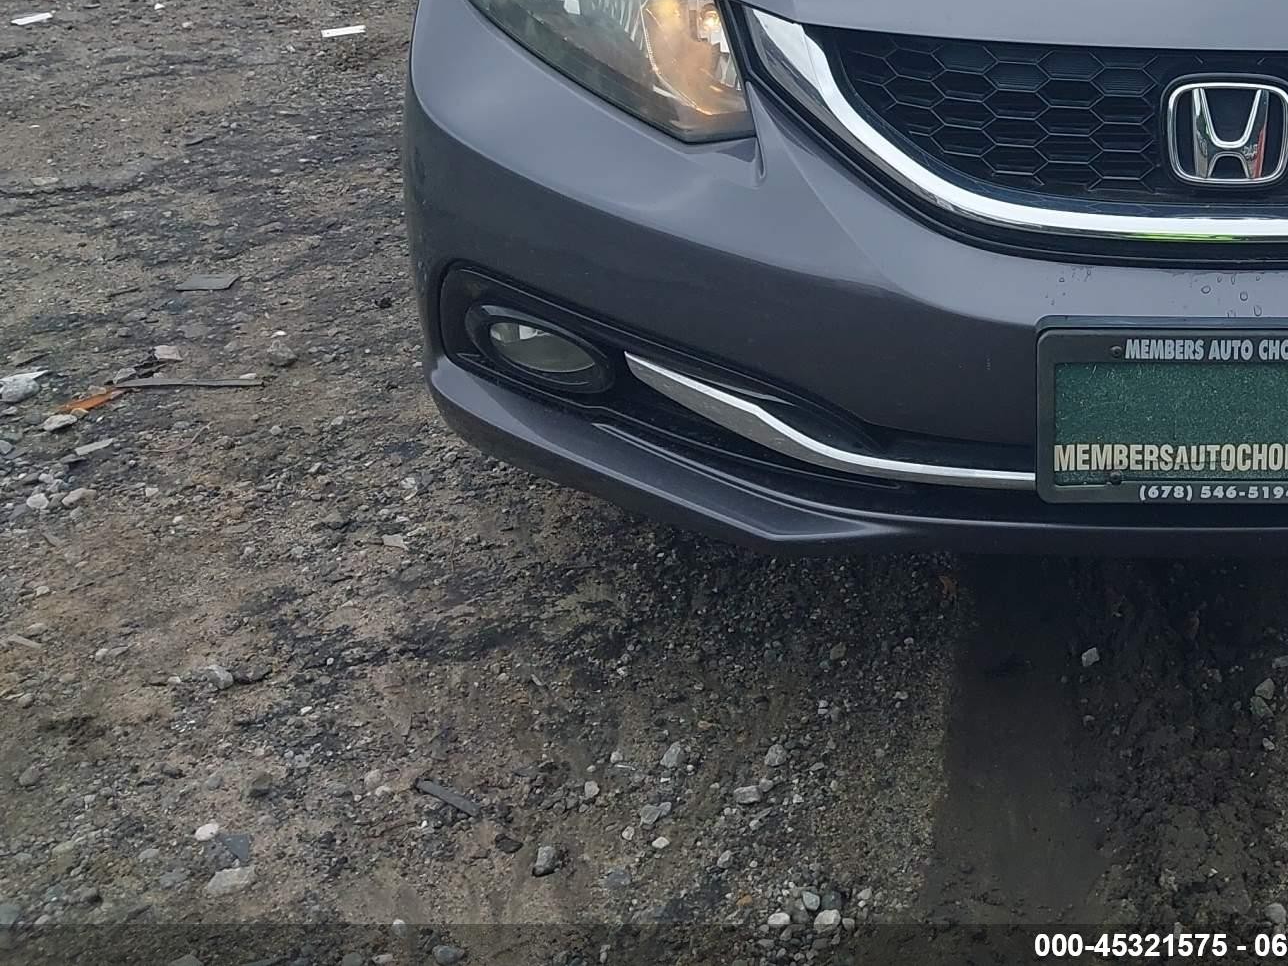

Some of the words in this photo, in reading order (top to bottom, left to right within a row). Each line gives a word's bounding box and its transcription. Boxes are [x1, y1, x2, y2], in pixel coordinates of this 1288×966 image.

[1124, 338, 1204, 361] MEMBERS
[1208, 339, 1253, 361] AUTO
[1139, 485, 1193, 501] (678)
